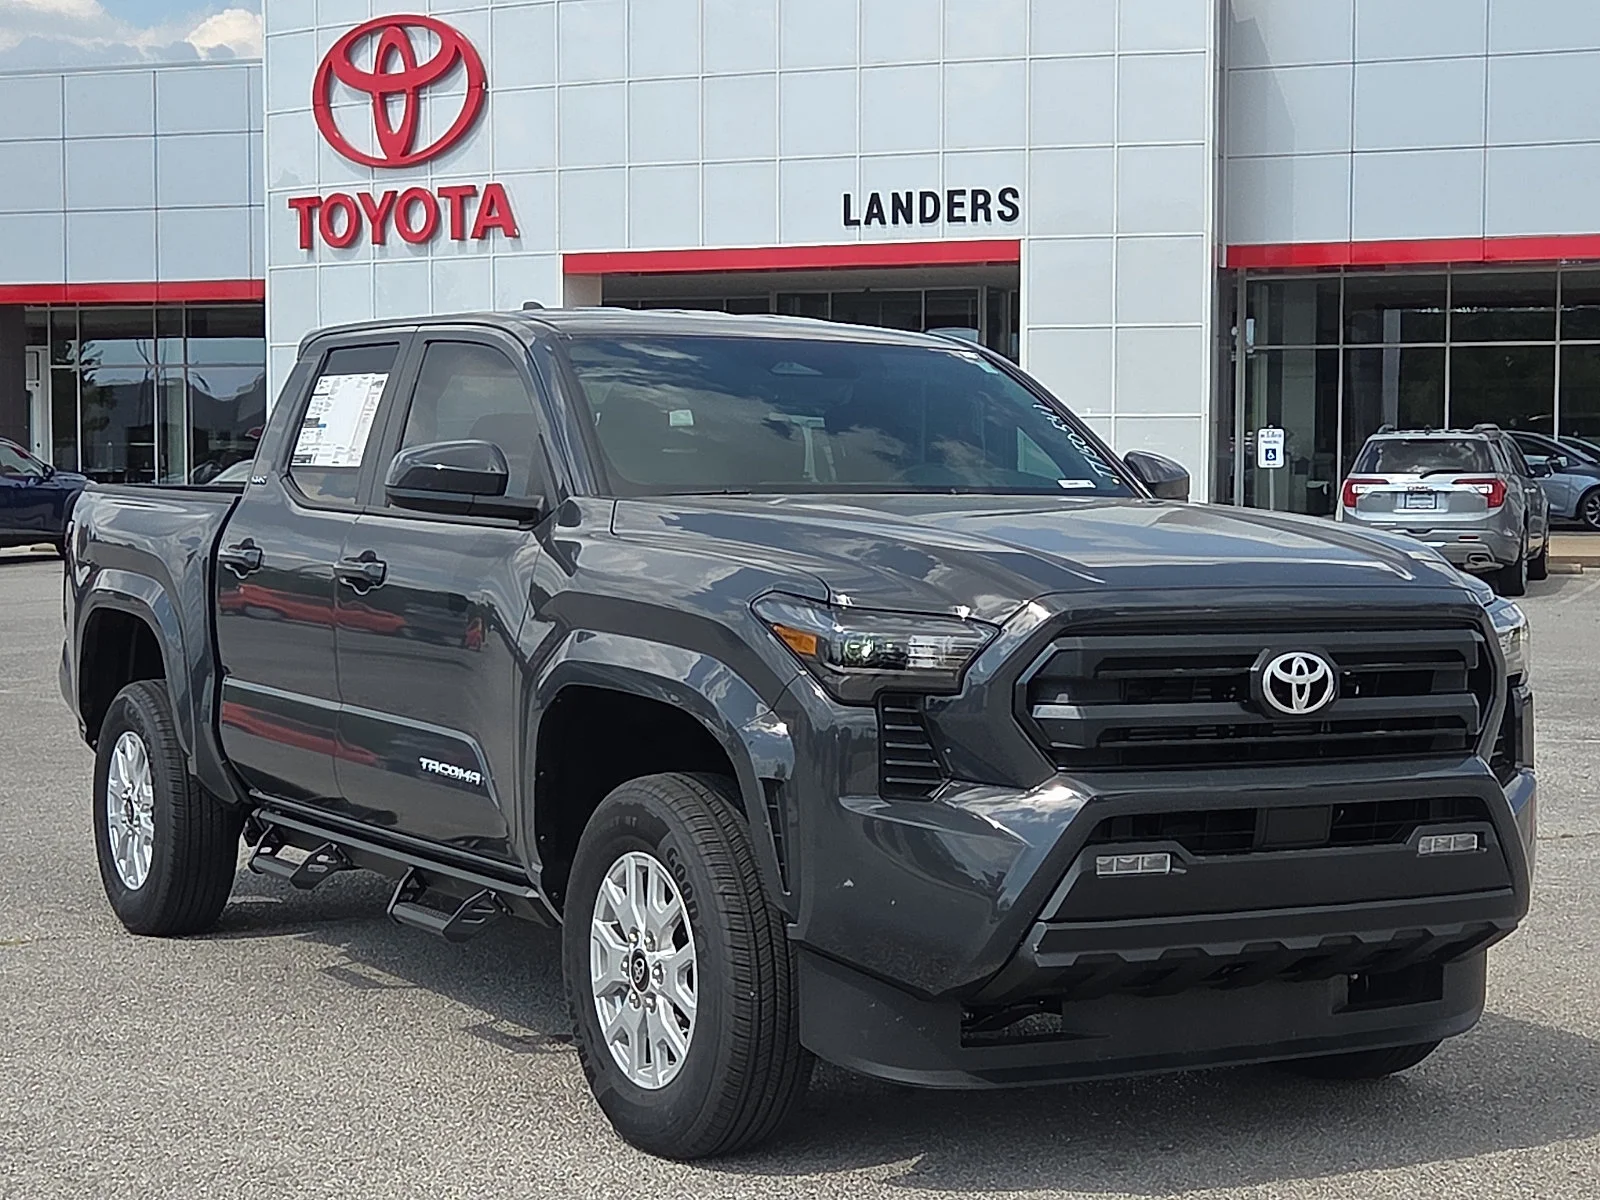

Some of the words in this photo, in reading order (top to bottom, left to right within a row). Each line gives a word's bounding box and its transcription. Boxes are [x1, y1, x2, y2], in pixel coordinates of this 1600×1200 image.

[288, 183, 520, 249] TOYOTA
[843, 187, 1020, 226] LANDERS
[420, 757, 481, 785] TACOMA
